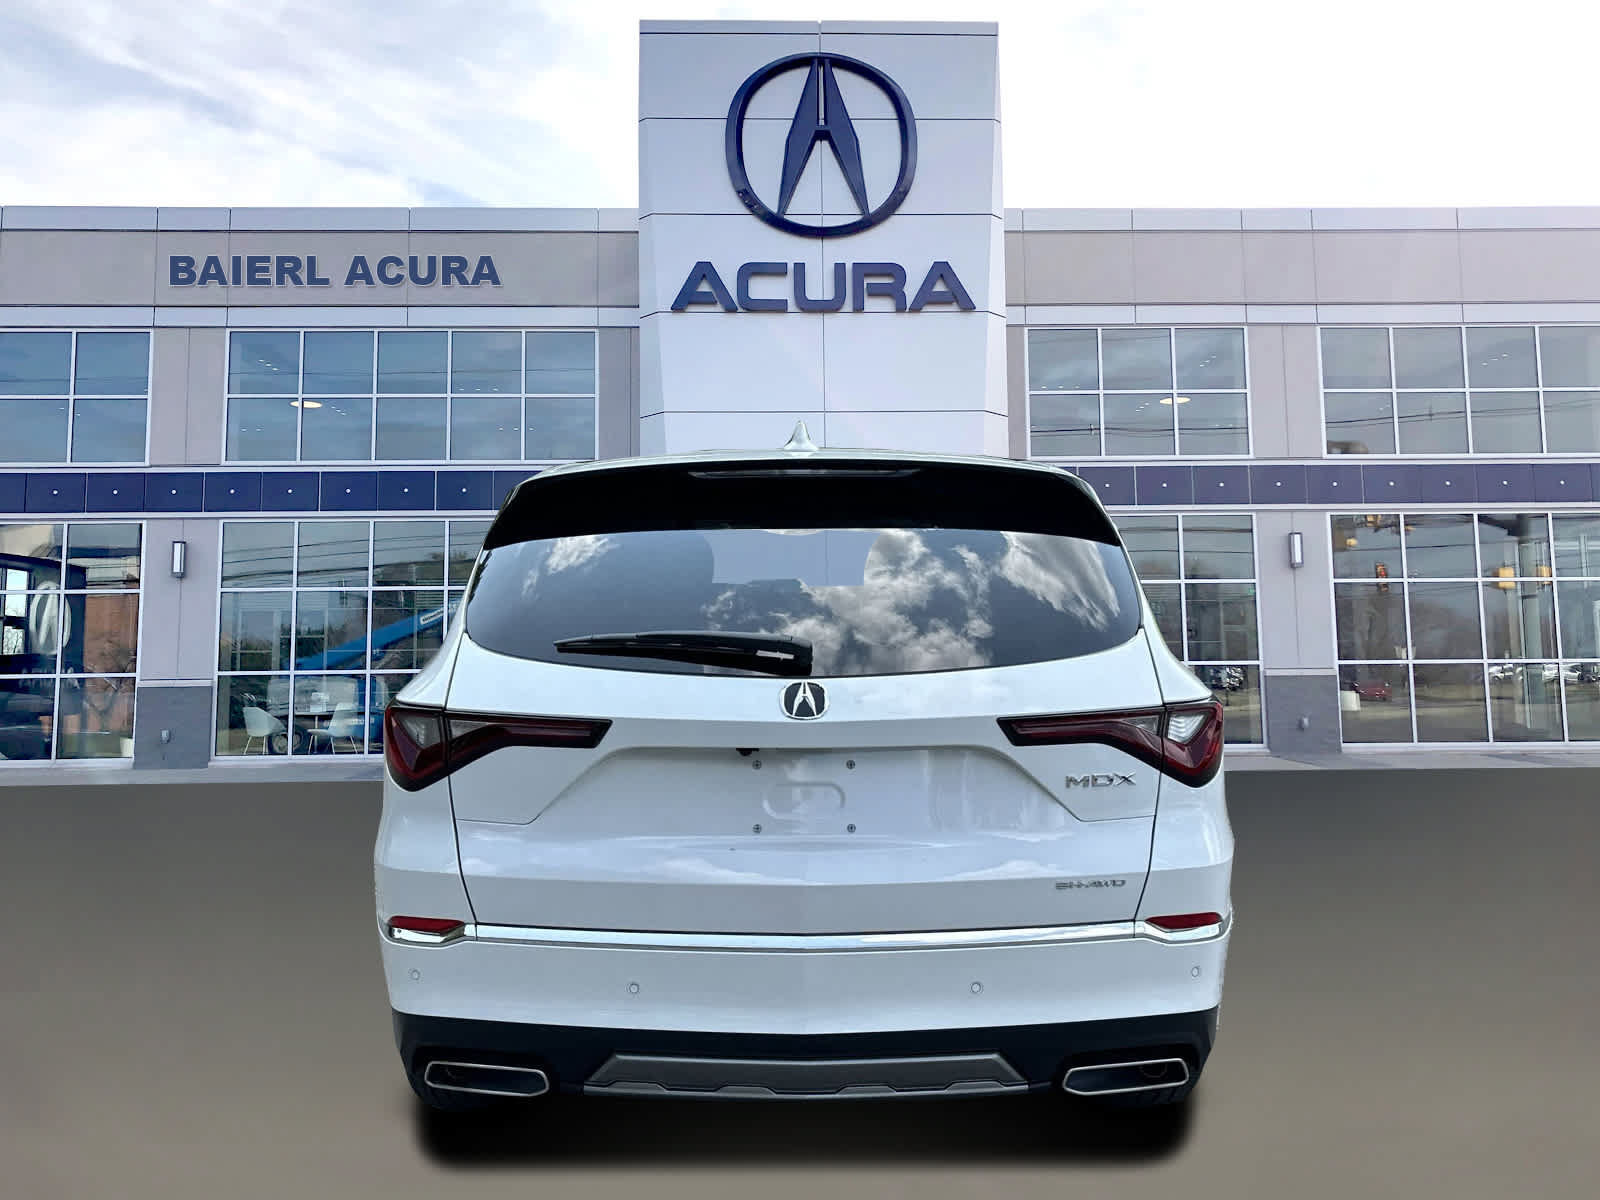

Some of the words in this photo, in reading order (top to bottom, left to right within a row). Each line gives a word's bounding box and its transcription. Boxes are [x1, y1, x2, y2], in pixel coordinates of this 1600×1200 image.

[169, 255, 330, 286] BAIERL
[344, 255, 501, 286] ACURA
[670, 261, 976, 312] ACURA
[1065, 772, 1136, 788] MDX
